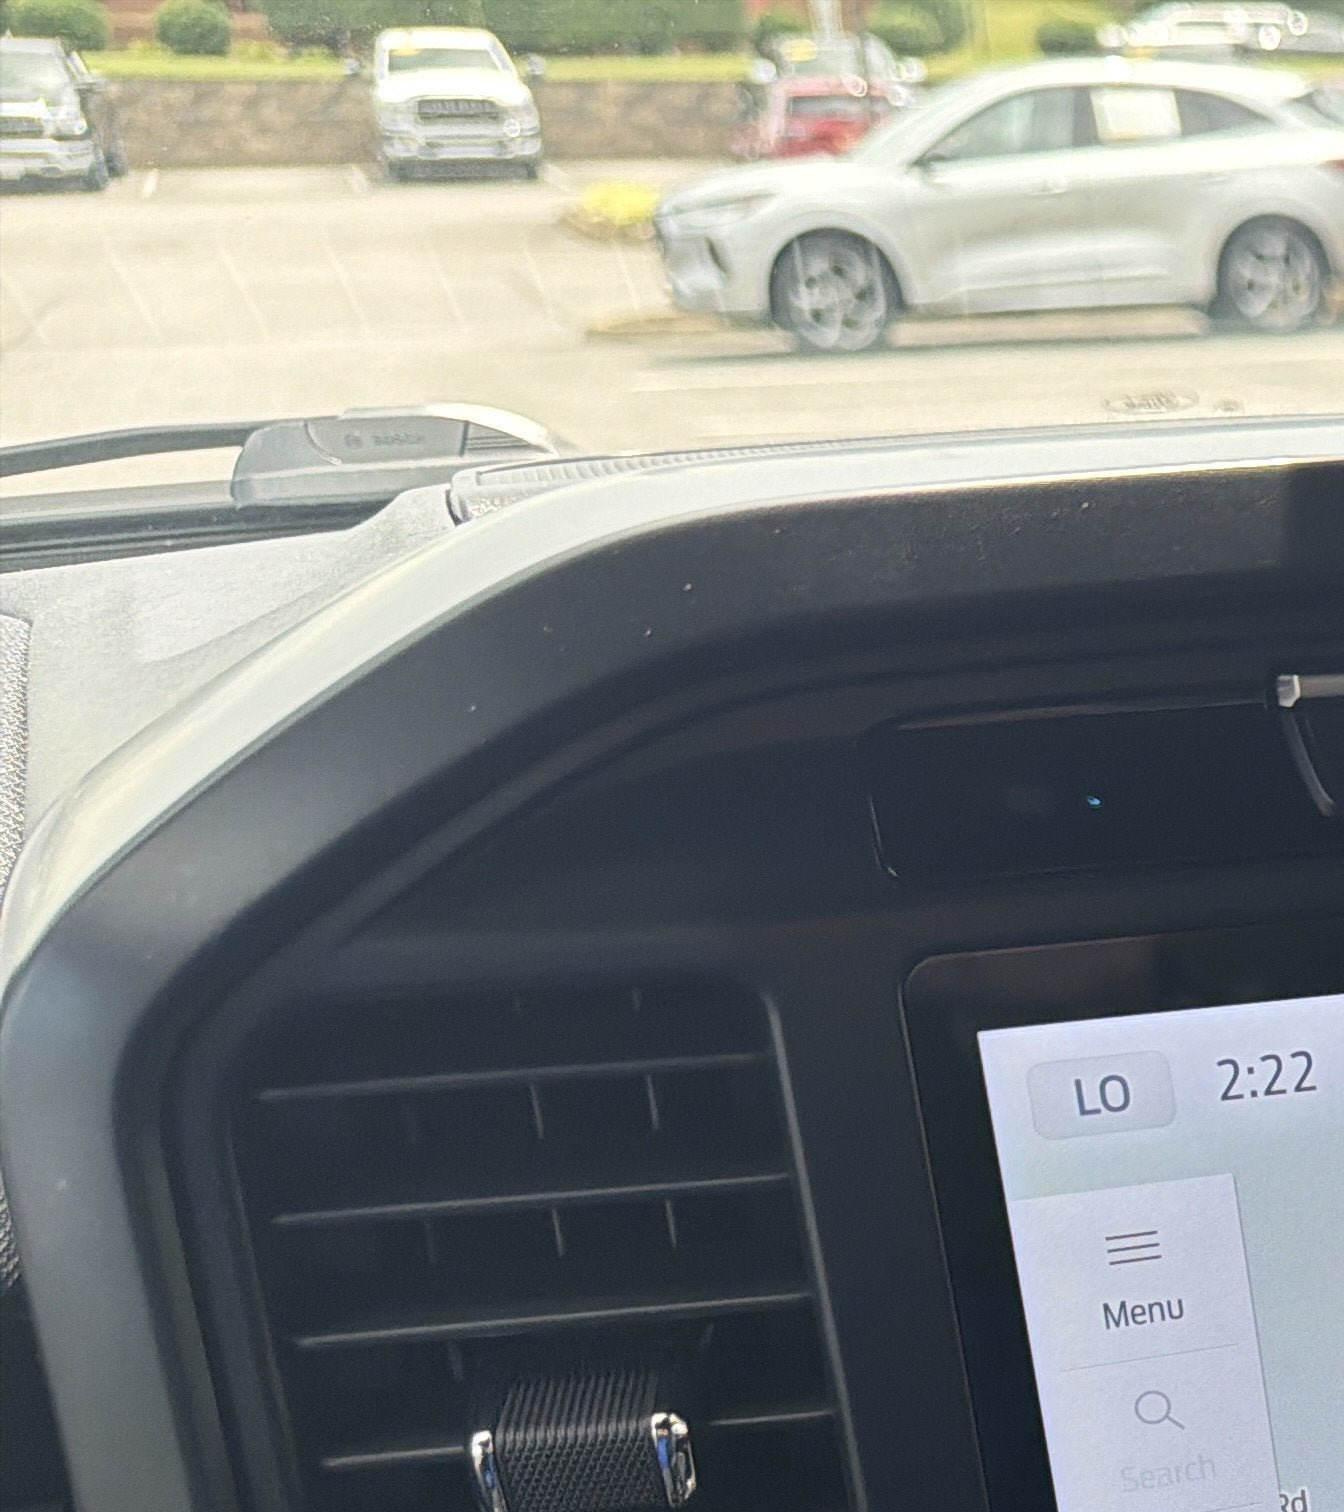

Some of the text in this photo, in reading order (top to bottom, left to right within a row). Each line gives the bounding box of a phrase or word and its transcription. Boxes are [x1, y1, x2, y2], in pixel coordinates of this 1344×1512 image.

[1074, 1073, 1131, 1116] LO
[1217, 1050, 1318, 1101] 2:22
[1102, 1297, 1184, 1329] Menu
[1120, 1454, 1216, 1495] Search
